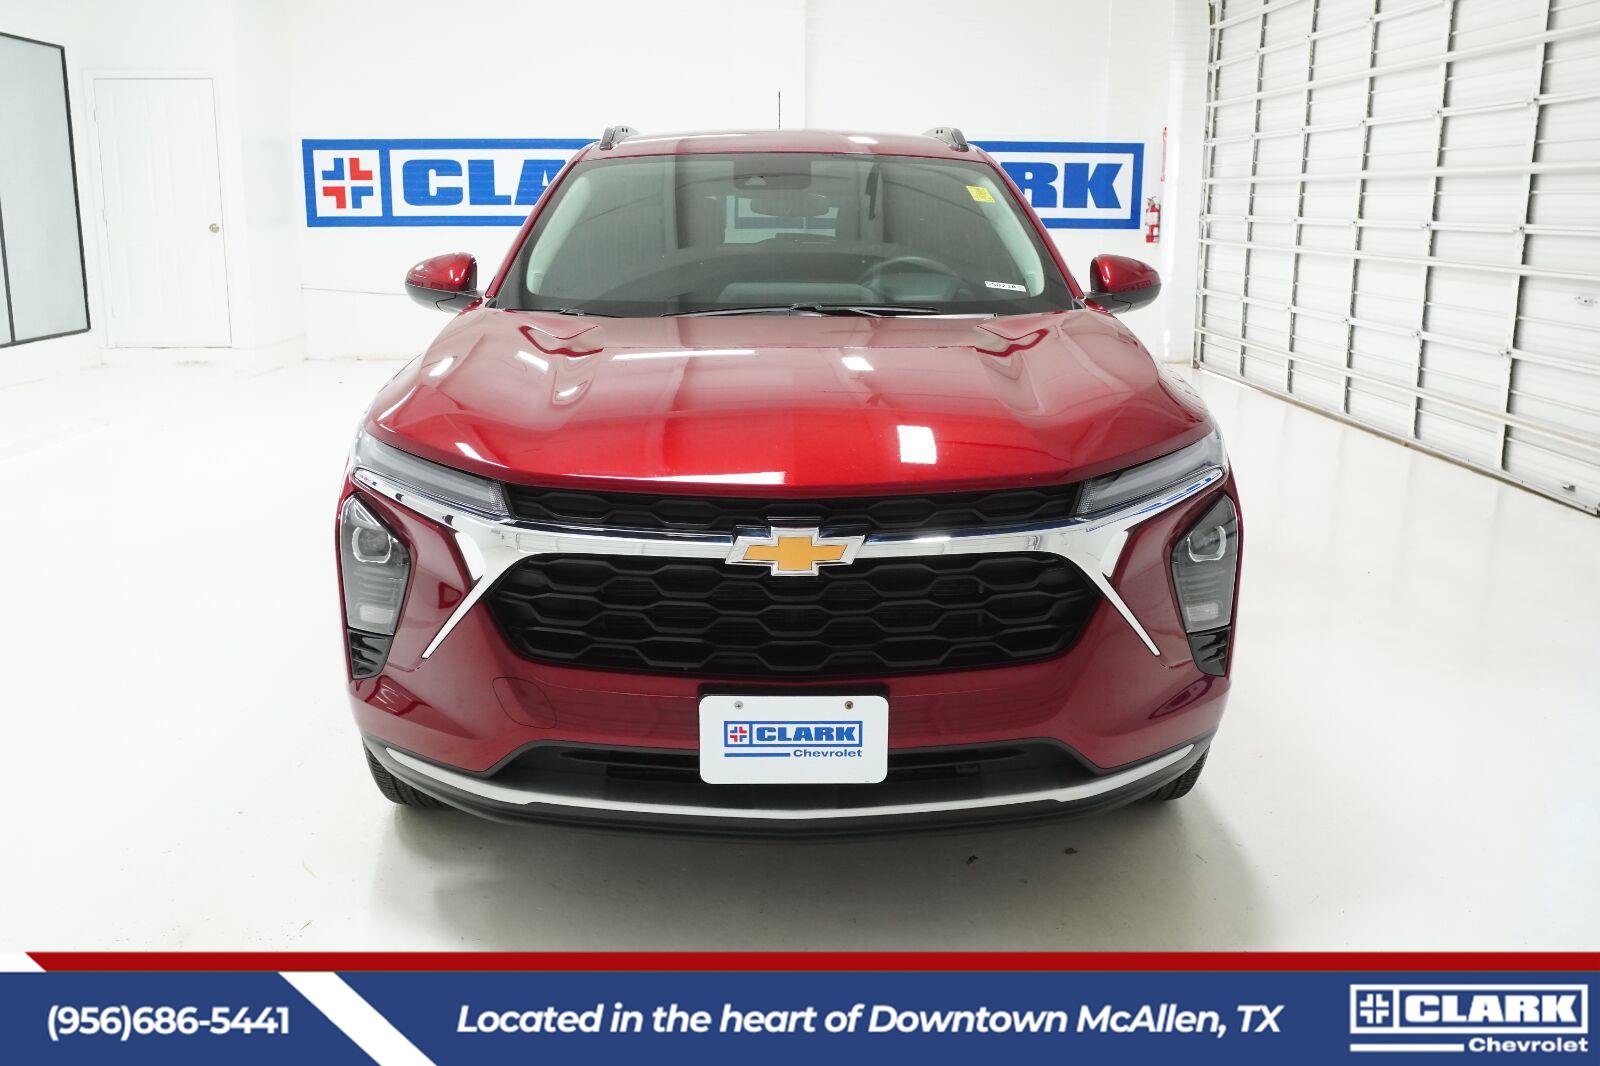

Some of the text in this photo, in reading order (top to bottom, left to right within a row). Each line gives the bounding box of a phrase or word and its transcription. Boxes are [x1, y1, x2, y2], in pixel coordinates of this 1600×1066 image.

[402, 159, 567, 206] CLA
[756, 726, 856, 742] CLARK
[793, 749, 863, 758] Chevrolet
